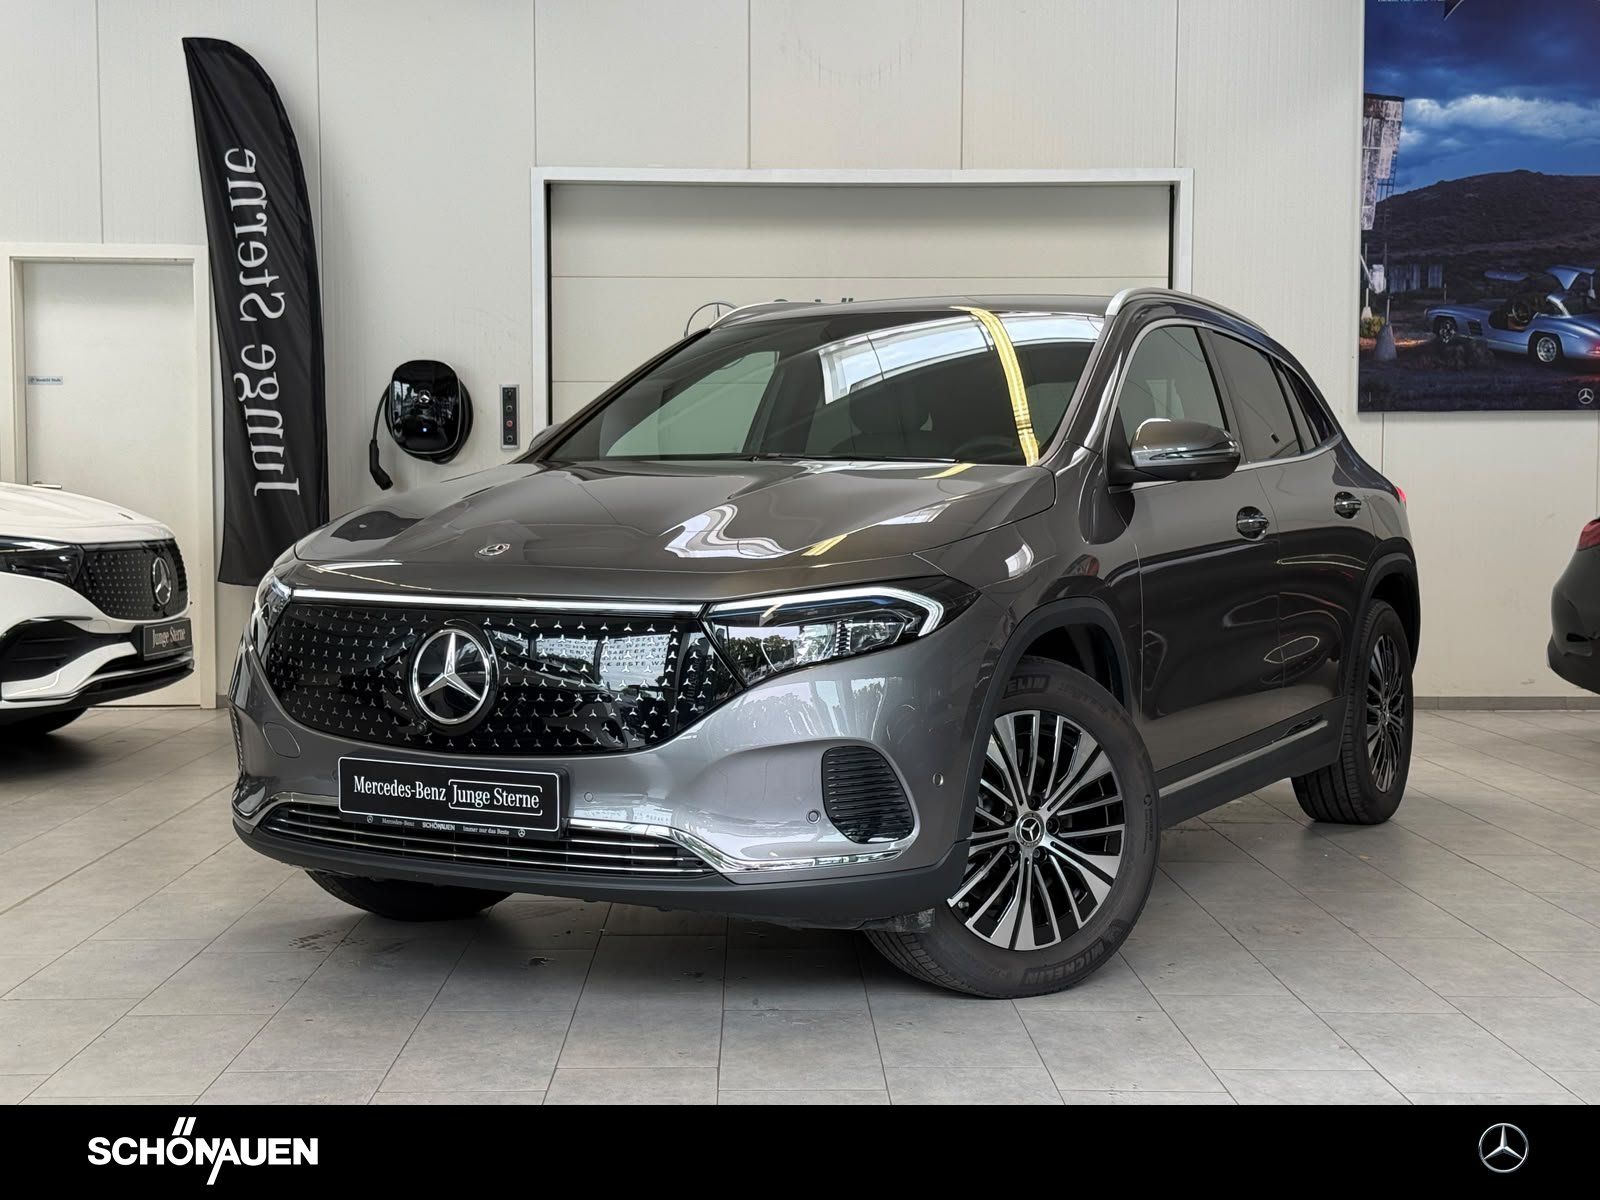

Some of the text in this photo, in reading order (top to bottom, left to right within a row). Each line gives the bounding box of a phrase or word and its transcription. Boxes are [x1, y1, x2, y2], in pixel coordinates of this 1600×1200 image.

[353, 775, 540, 809] Mercedes-Benz Junge Sterne
[1025, 941, 1105, 985] MICHELIN
